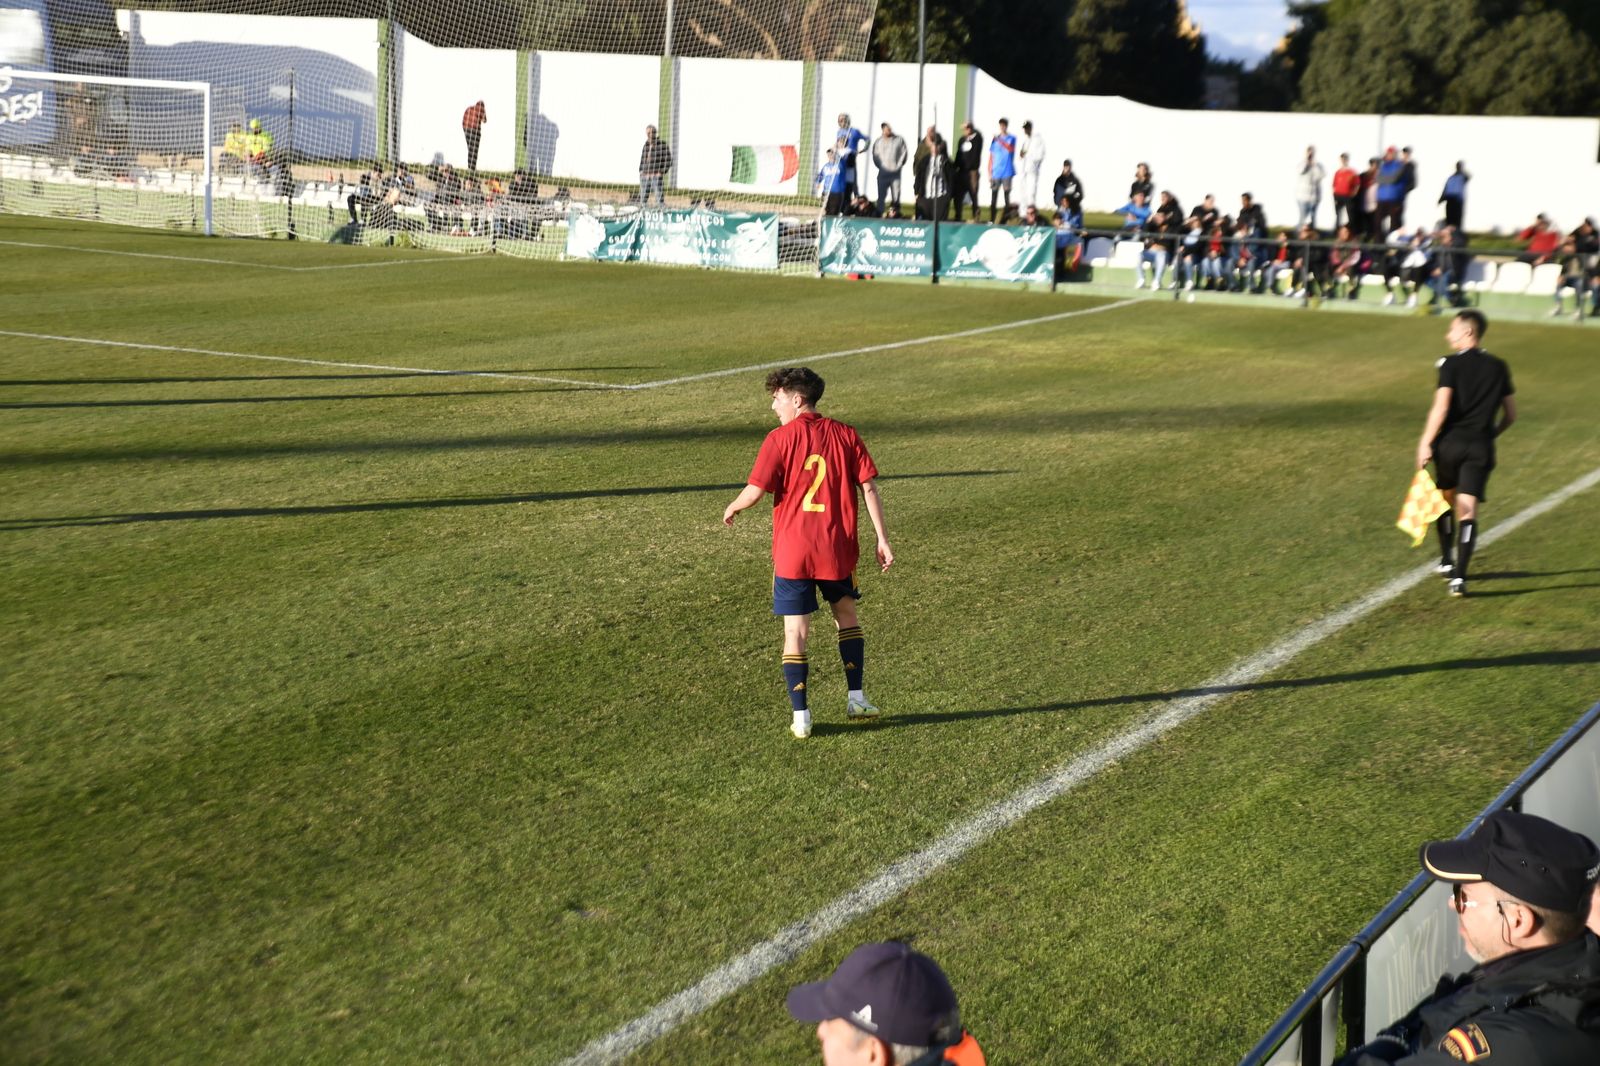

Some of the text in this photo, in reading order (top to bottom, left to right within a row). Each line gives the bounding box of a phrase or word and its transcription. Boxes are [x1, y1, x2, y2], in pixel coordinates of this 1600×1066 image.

[880, 226, 925, 238] PACO OLEA
[802, 453, 828, 513] 2
